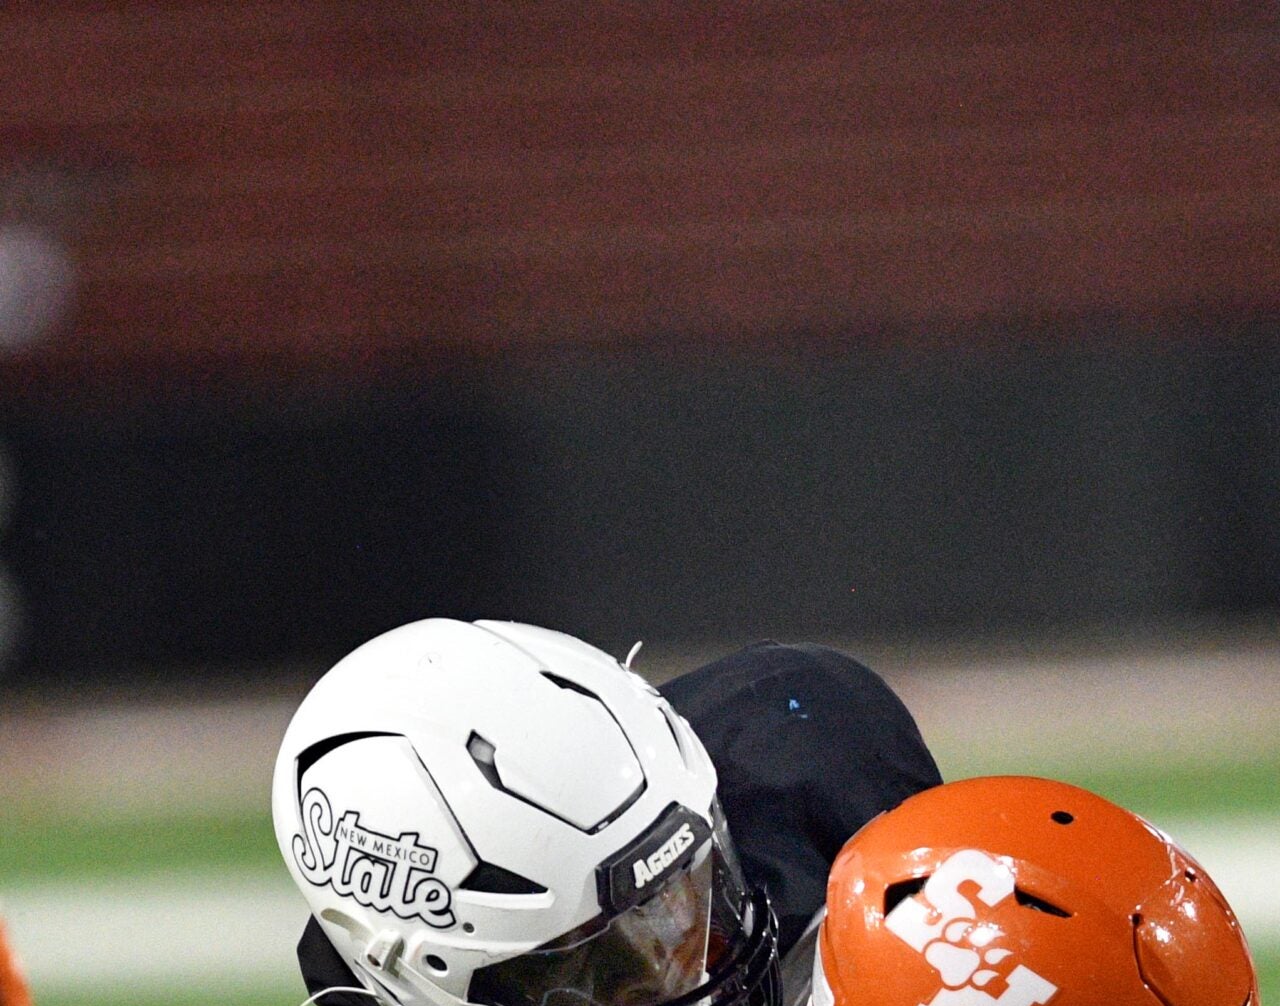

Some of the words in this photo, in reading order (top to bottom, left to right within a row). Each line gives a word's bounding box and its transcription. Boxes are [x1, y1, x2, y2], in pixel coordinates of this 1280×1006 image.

[291, 787, 457, 929] State
[340, 827, 367, 847] NEW
[372, 841, 431, 866] MEXICO
[633, 822, 695, 889] AGGIES
